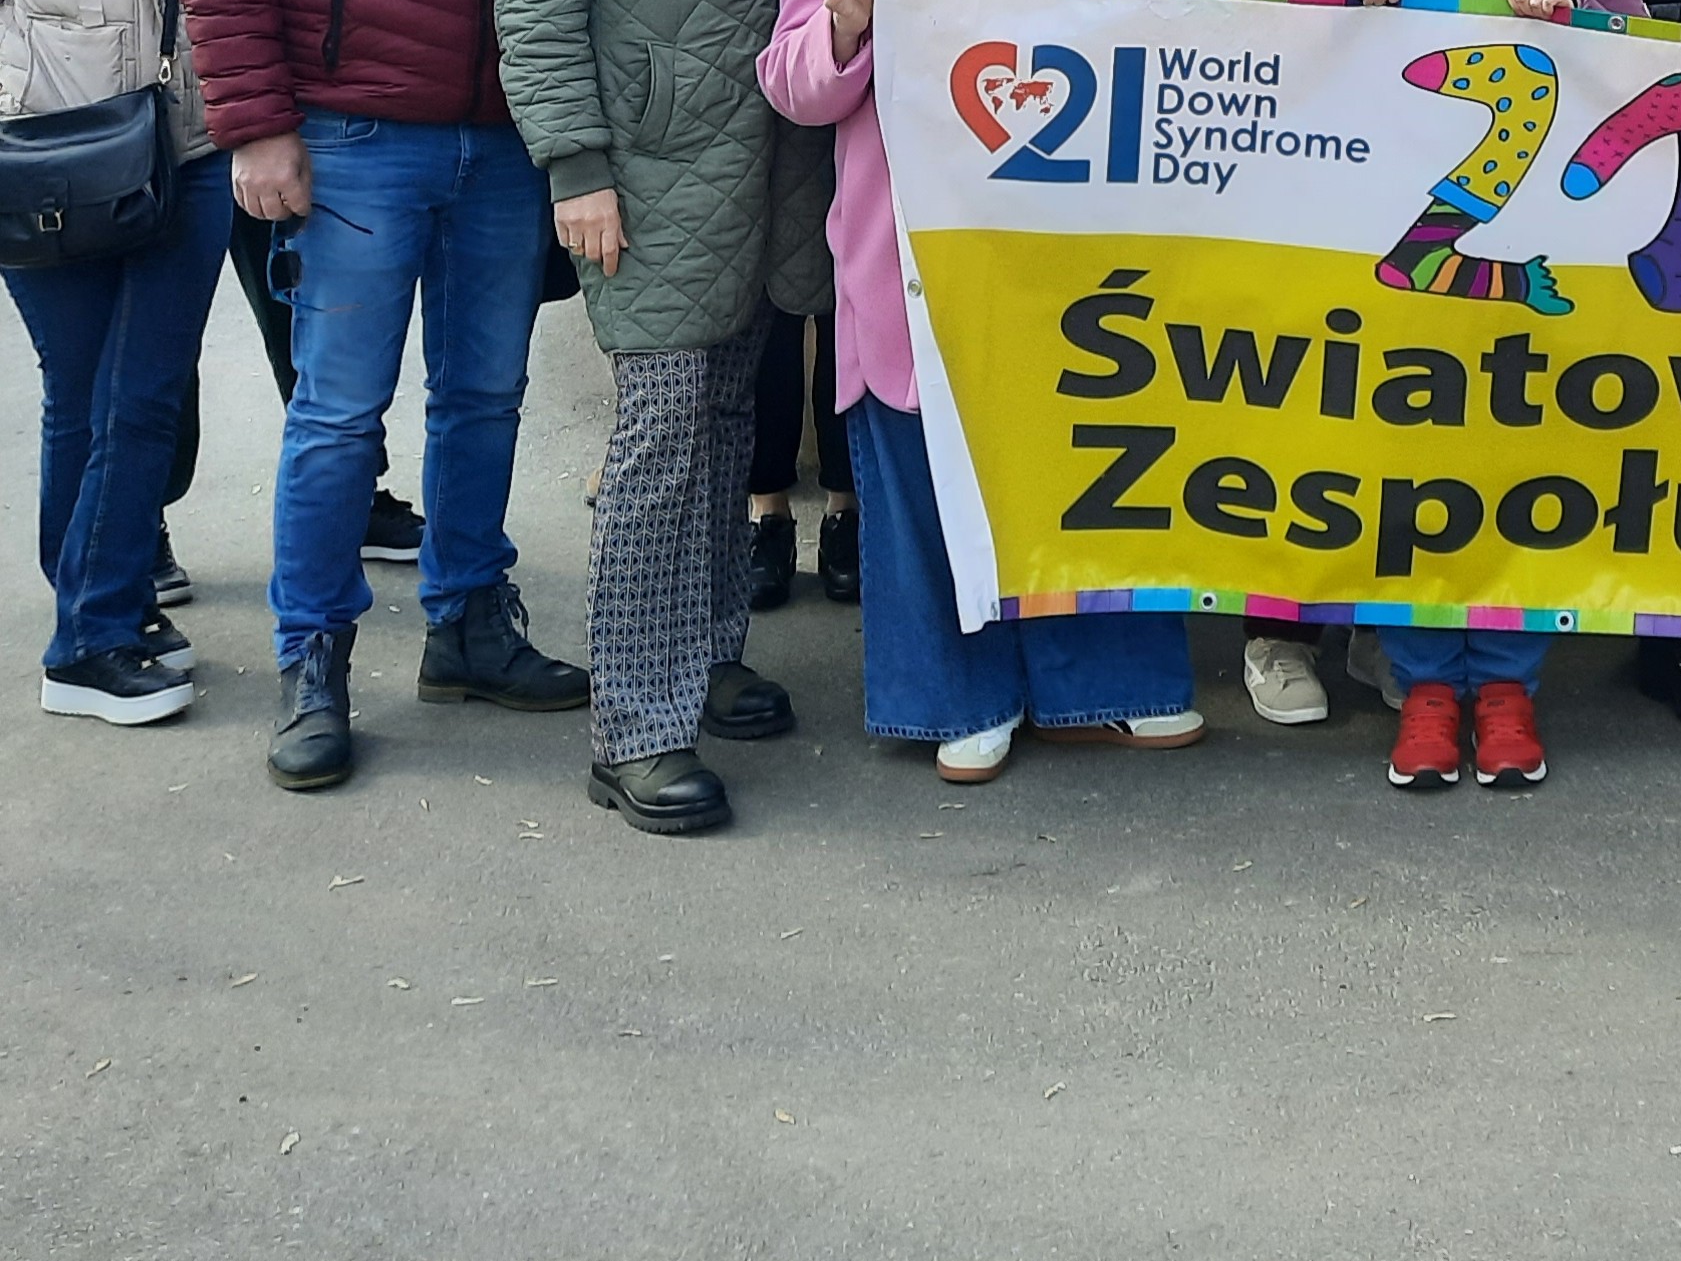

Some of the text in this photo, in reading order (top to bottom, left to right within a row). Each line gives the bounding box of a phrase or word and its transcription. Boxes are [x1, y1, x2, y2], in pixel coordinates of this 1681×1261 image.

[1158, 47, 1281, 86] World
[1156, 84, 1278, 118] Down
[1152, 117, 1372, 164] Syndrome
[1152, 153, 1238, 195] Day
